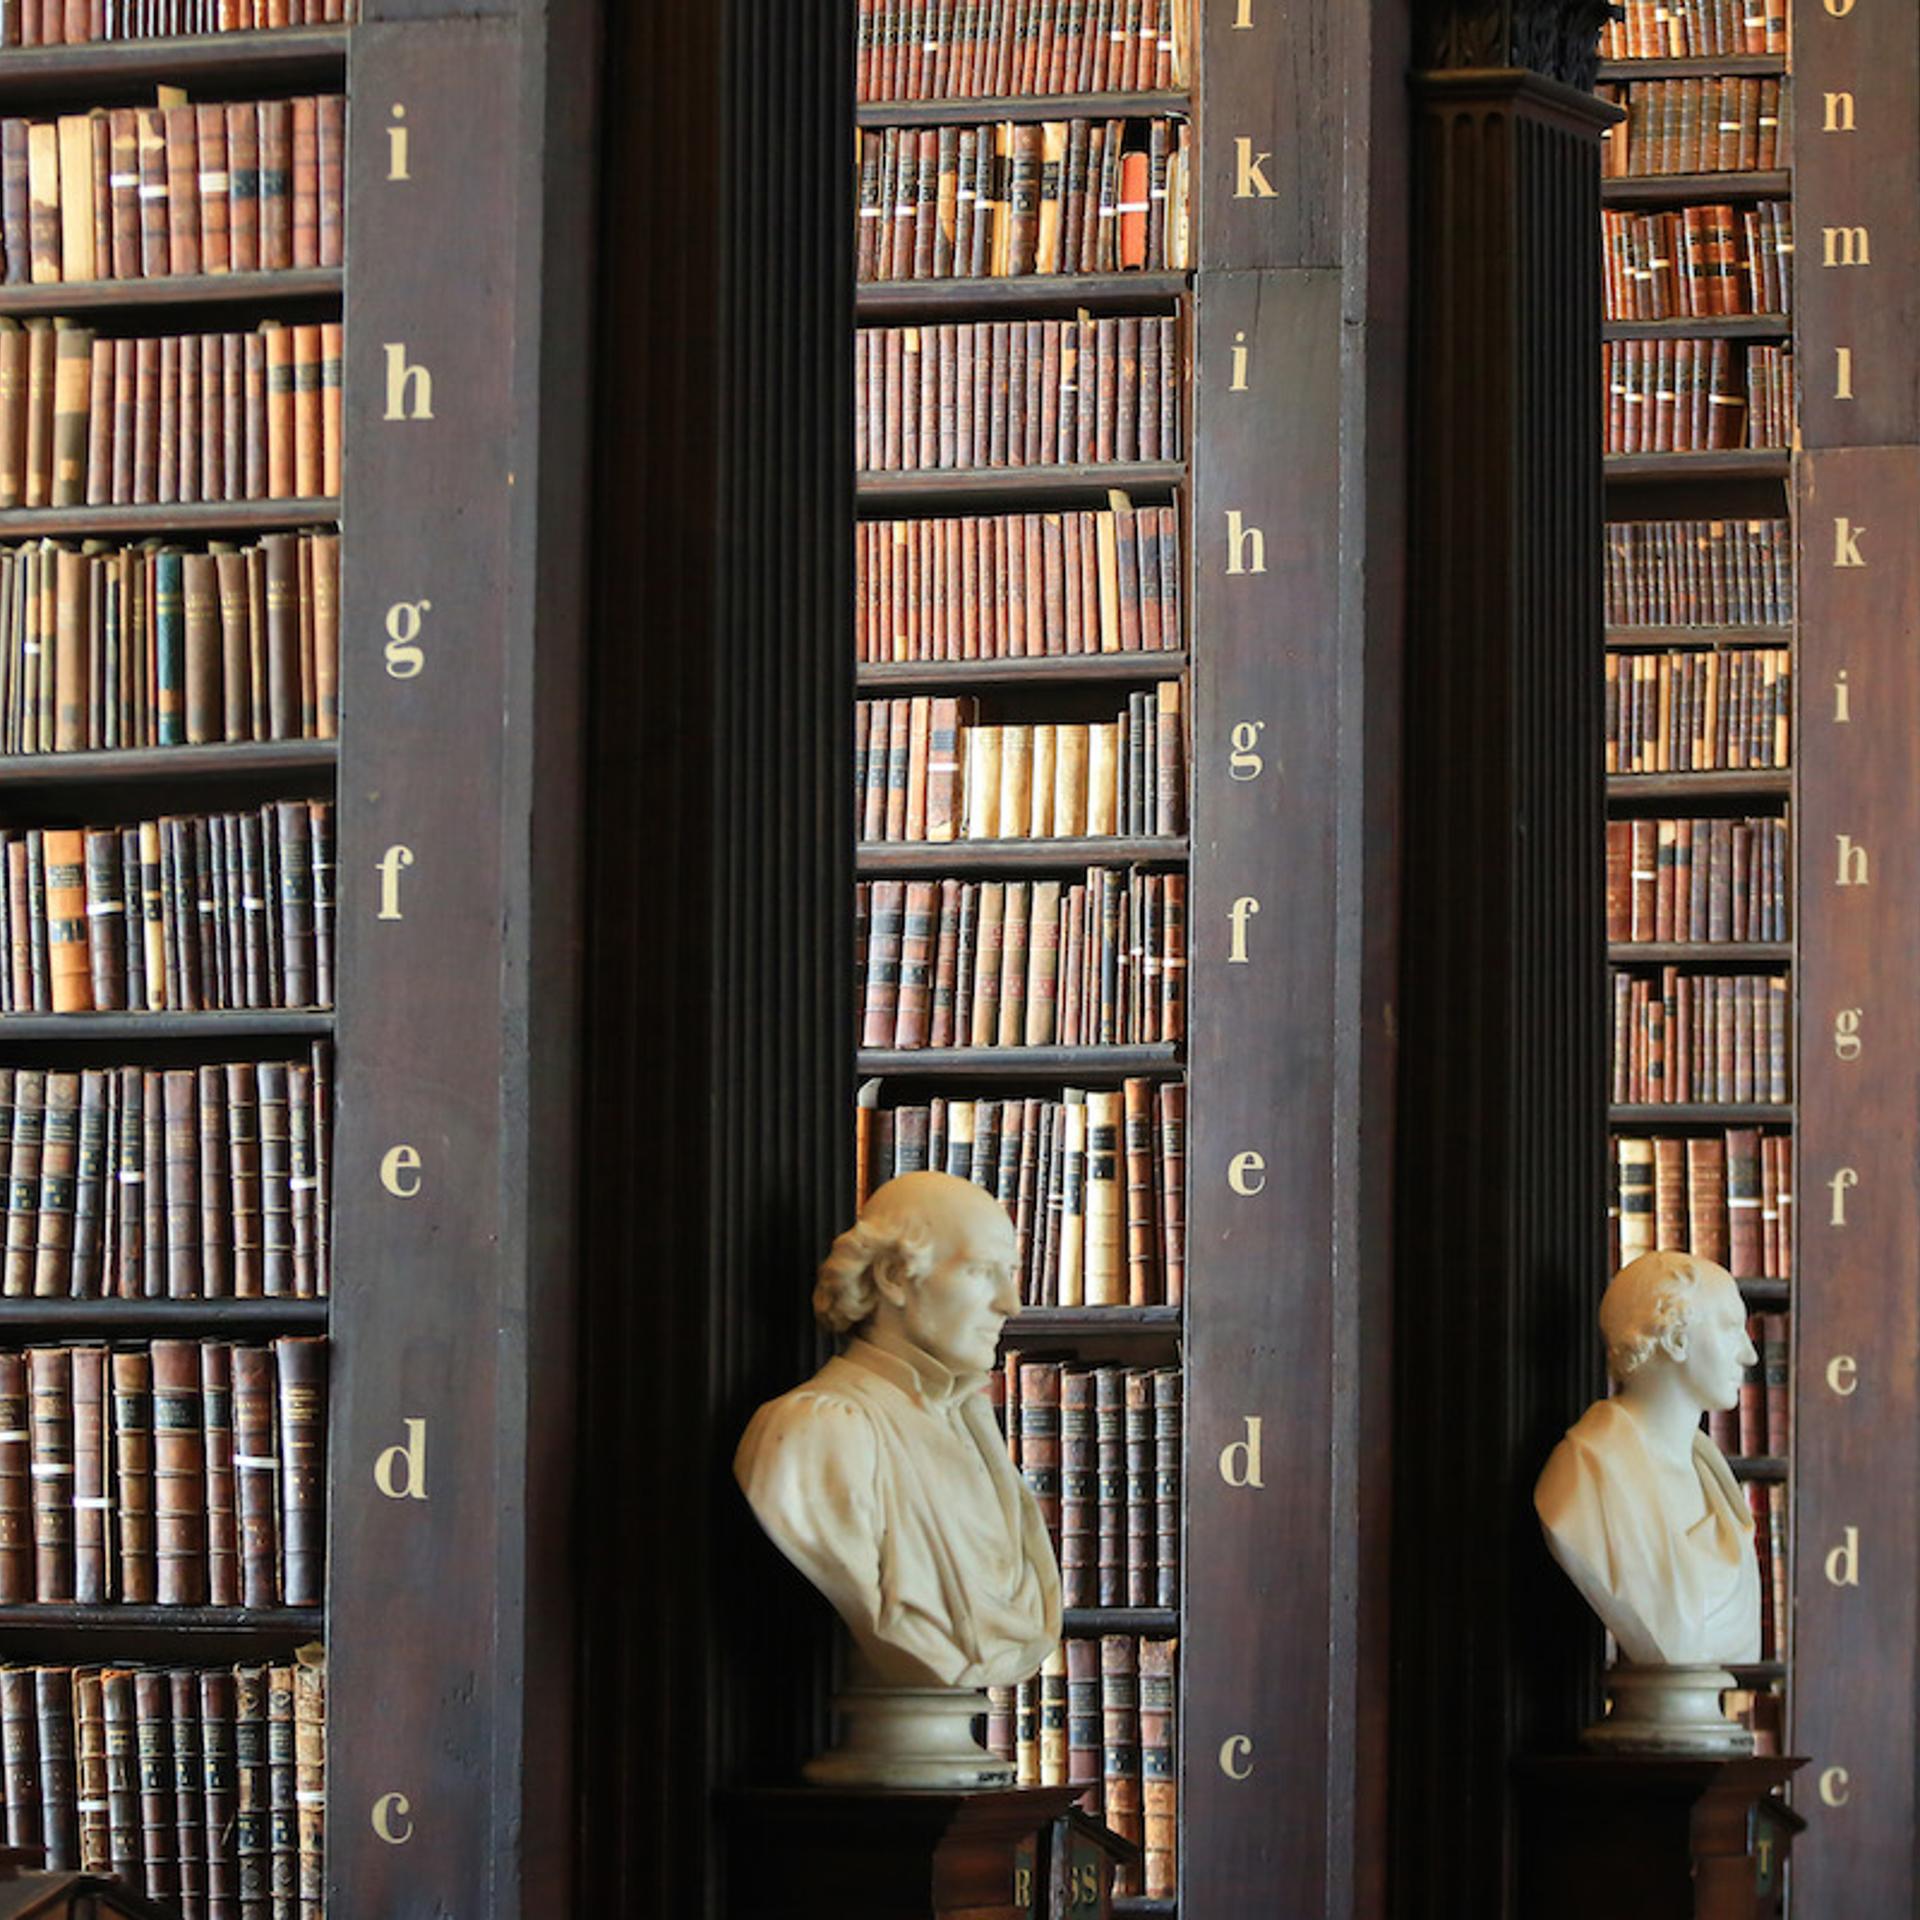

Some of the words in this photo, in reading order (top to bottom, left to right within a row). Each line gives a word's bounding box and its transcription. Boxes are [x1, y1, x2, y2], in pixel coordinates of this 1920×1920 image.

[1823, 92, 1856, 131] n
[387, 104, 411, 181] i
[1233, 137, 1279, 198] k
[1822, 227, 1870, 266] m
[383, 343, 434, 421] h
[1228, 332, 1250, 391] i
[1226, 510, 1265, 575] h
[1833, 517, 1867, 567] k
[384, 600, 432, 679] g
[1833, 670, 1850, 723] i
[1230, 721, 1266, 779] g
[375, 845, 415, 921] f
[1834, 835, 1869, 887] h
[1227, 896, 1261, 963] f
[1834, 1008, 1864, 1060] g
[380, 1144, 422, 1197] e
[1228, 1151, 1265, 1196] e
[1827, 1167, 1859, 1226] f
[1825, 1354, 1858, 1396] e
[374, 1418, 427, 1499] d
[1218, 1415, 1263, 1488] d
[1824, 1525, 1859, 1587] d
[1219, 1735, 1255, 1780] c
[1819, 1766, 1849, 1806] c
[371, 1792, 412, 1844] c
